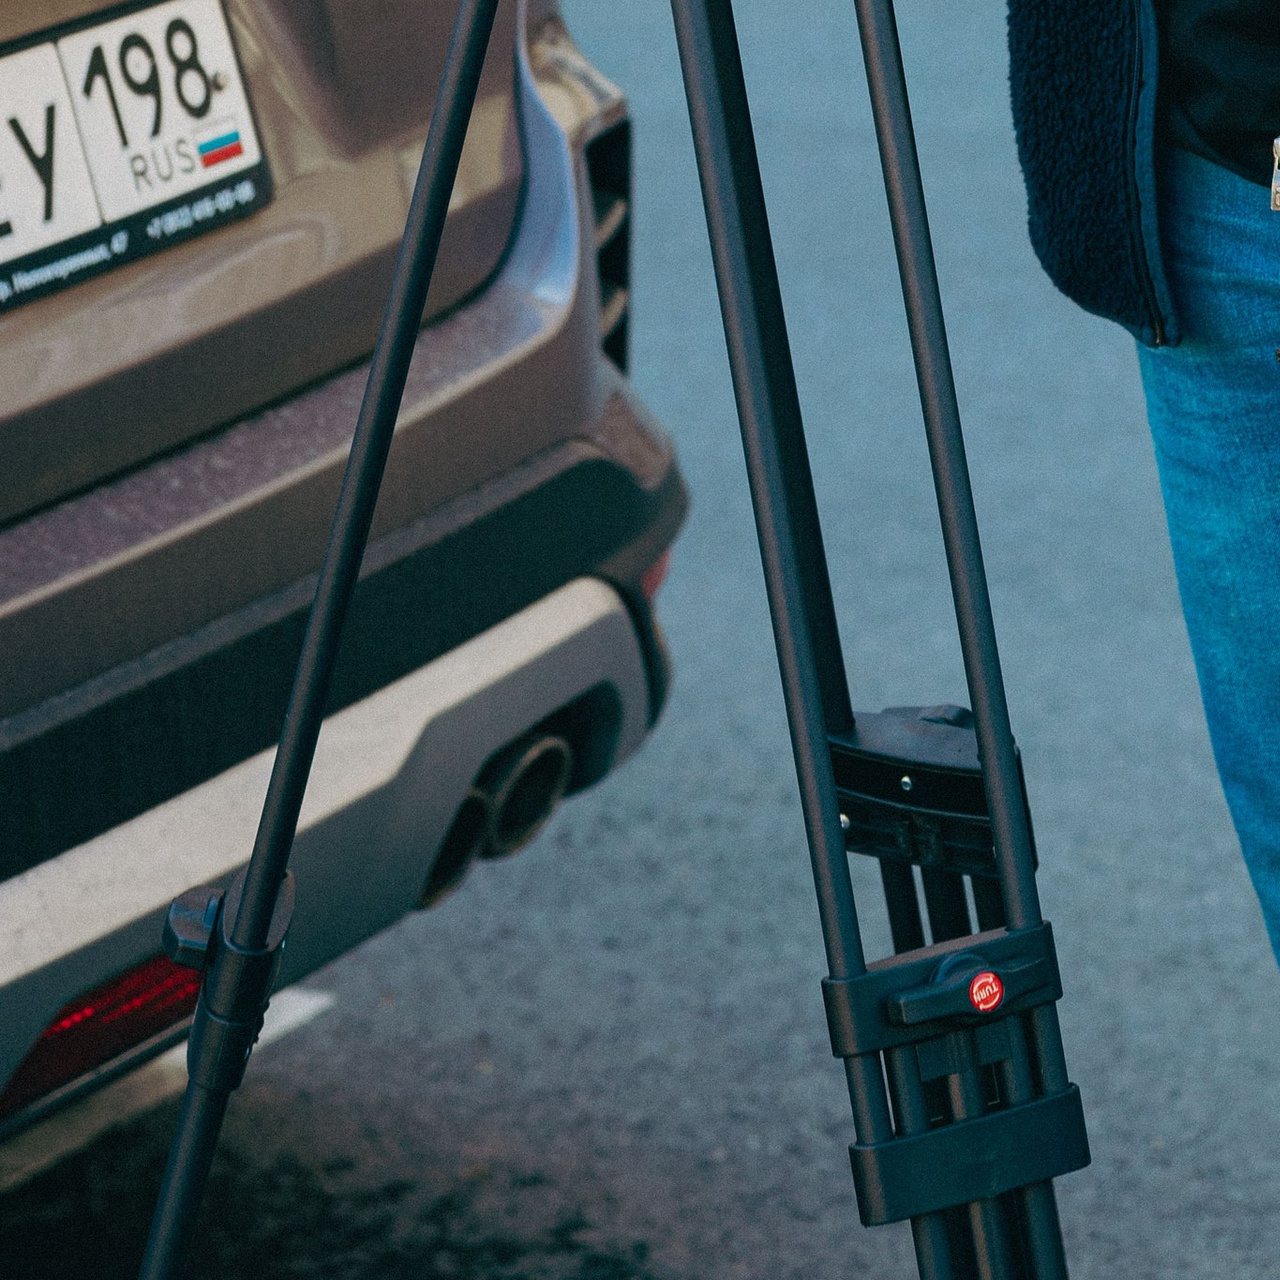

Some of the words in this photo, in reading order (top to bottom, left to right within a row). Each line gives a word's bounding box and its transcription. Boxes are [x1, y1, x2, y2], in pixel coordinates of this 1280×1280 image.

[83, 16, 212, 148] 198
[129, 138, 197, 191] RUS
[973, 981, 999, 1004] TURN
